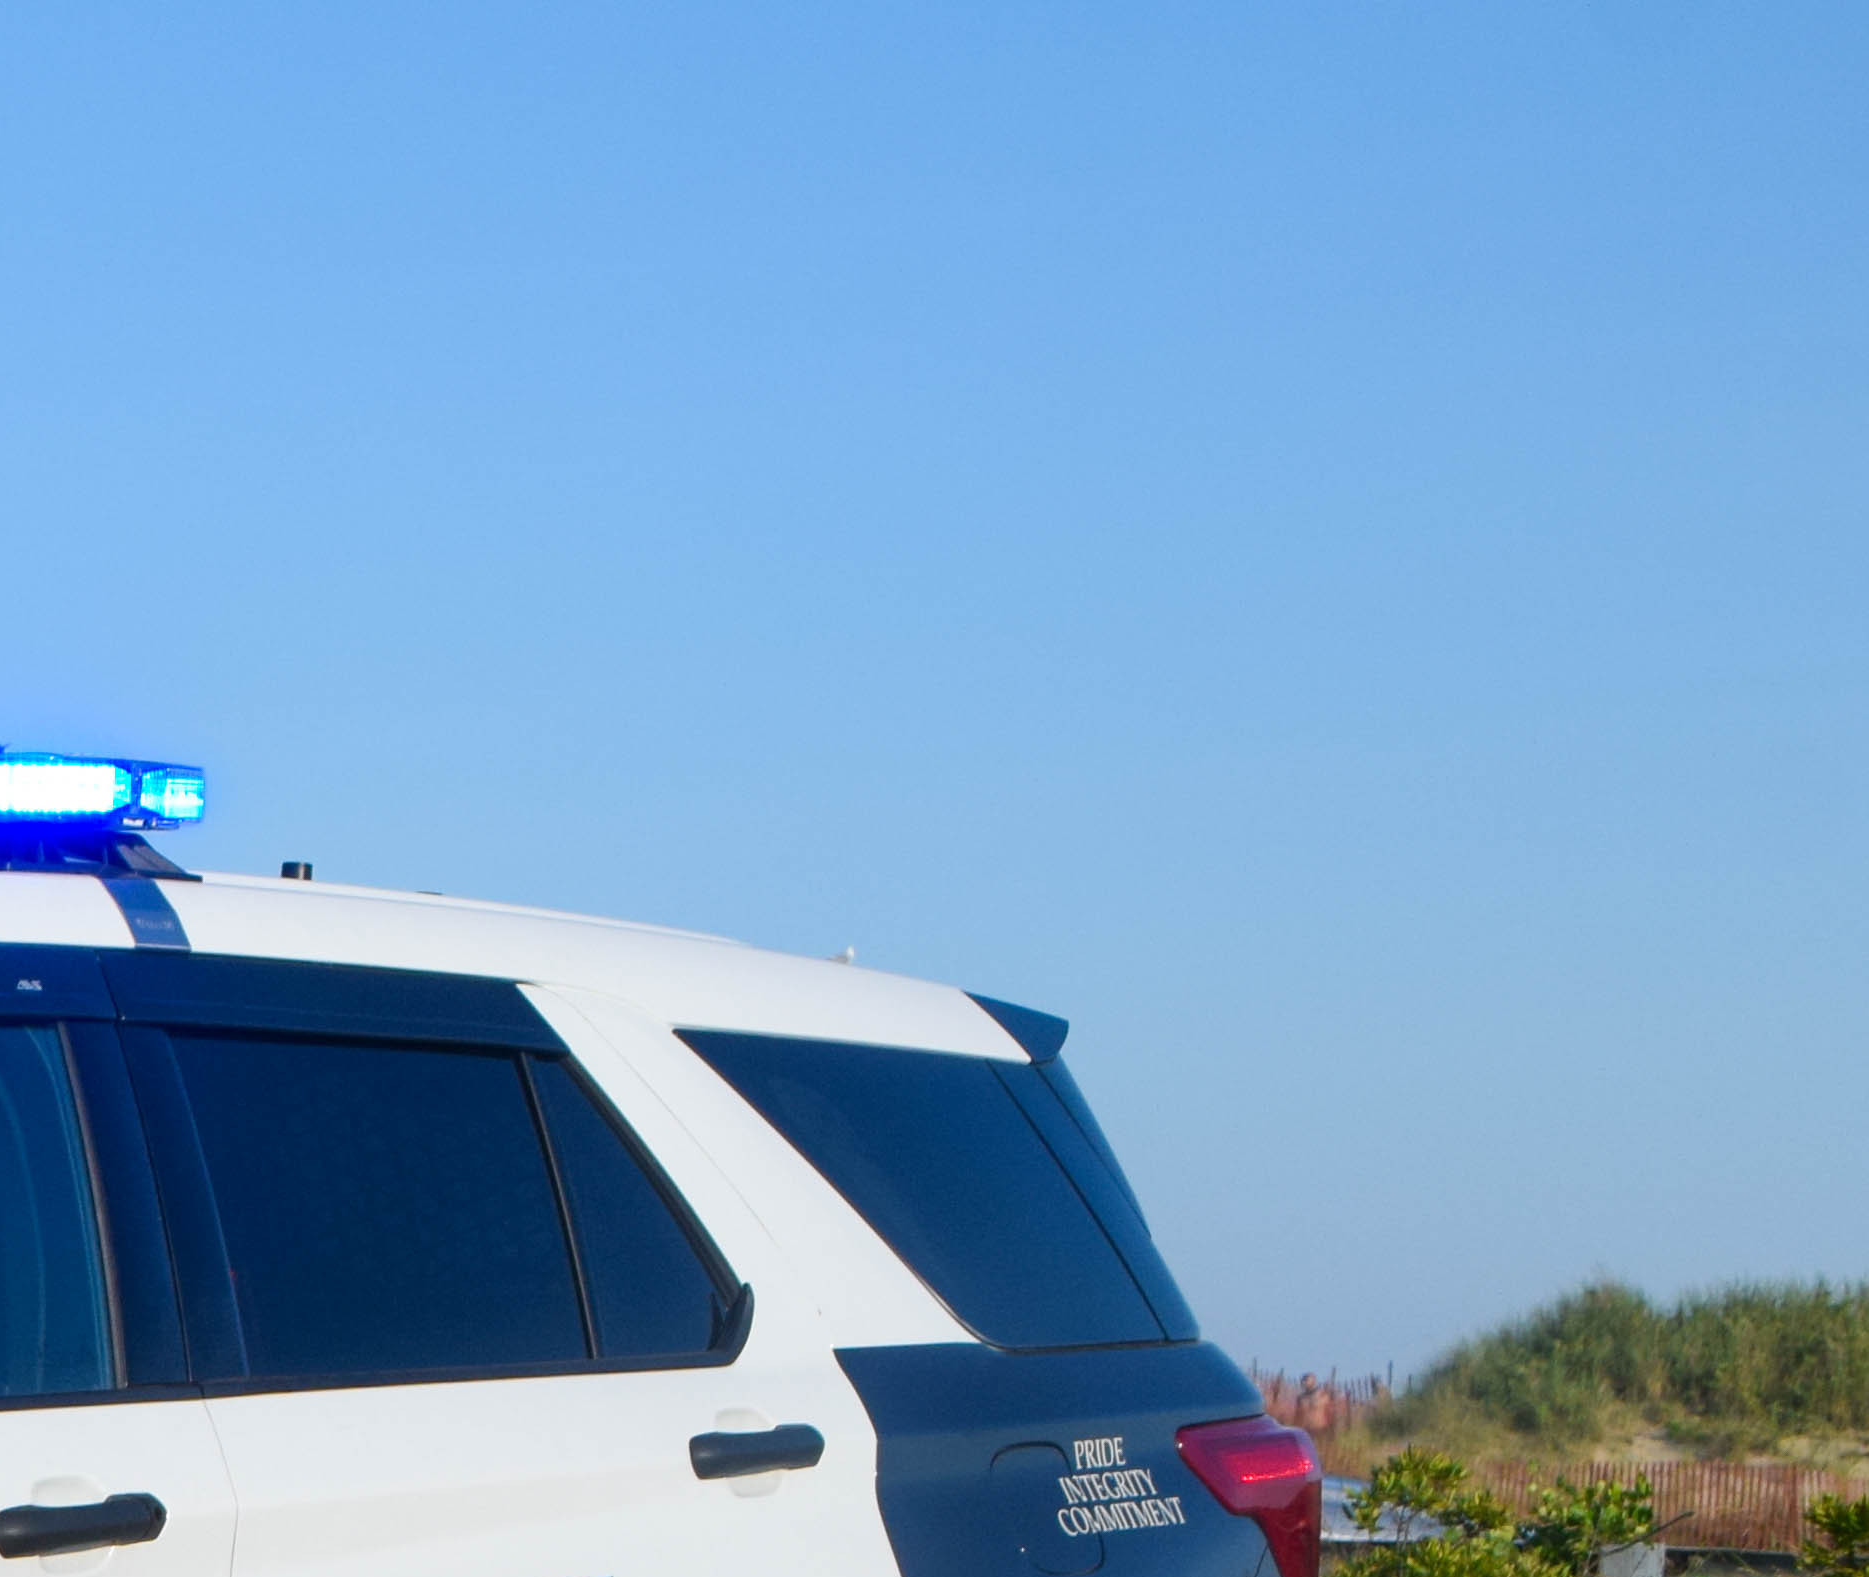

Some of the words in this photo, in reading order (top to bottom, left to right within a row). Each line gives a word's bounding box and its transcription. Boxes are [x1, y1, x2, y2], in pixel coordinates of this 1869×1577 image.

[1073, 1437, 1126, 1470] PRIDE
[1058, 1468, 1158, 1504] INTEGRITY
[1057, 1496, 1186, 1537] COMMITMENT
